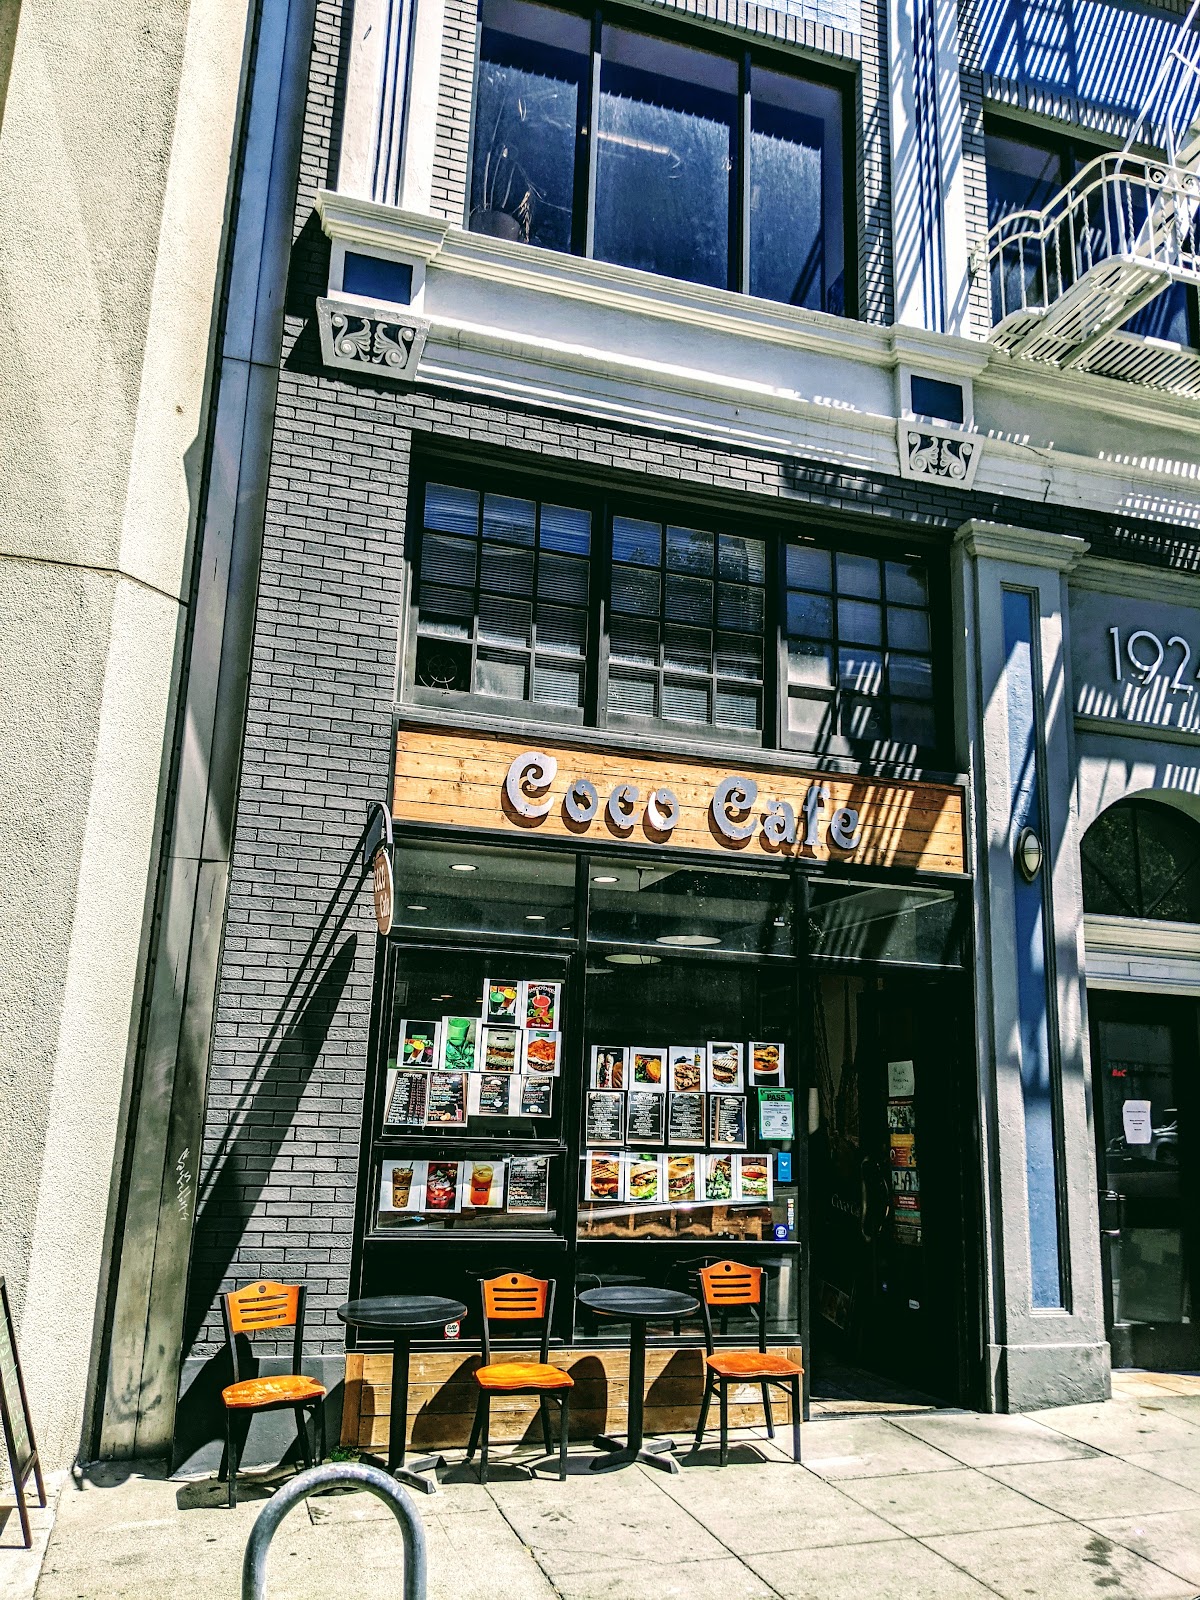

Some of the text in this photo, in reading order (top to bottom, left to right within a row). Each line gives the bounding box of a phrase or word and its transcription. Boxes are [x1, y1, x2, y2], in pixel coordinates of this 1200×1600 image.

[1109, 626, 1200, 691] 192
[506, 751, 862, 849] Coco Cafe
[766, 1093, 786, 1101] PASS
